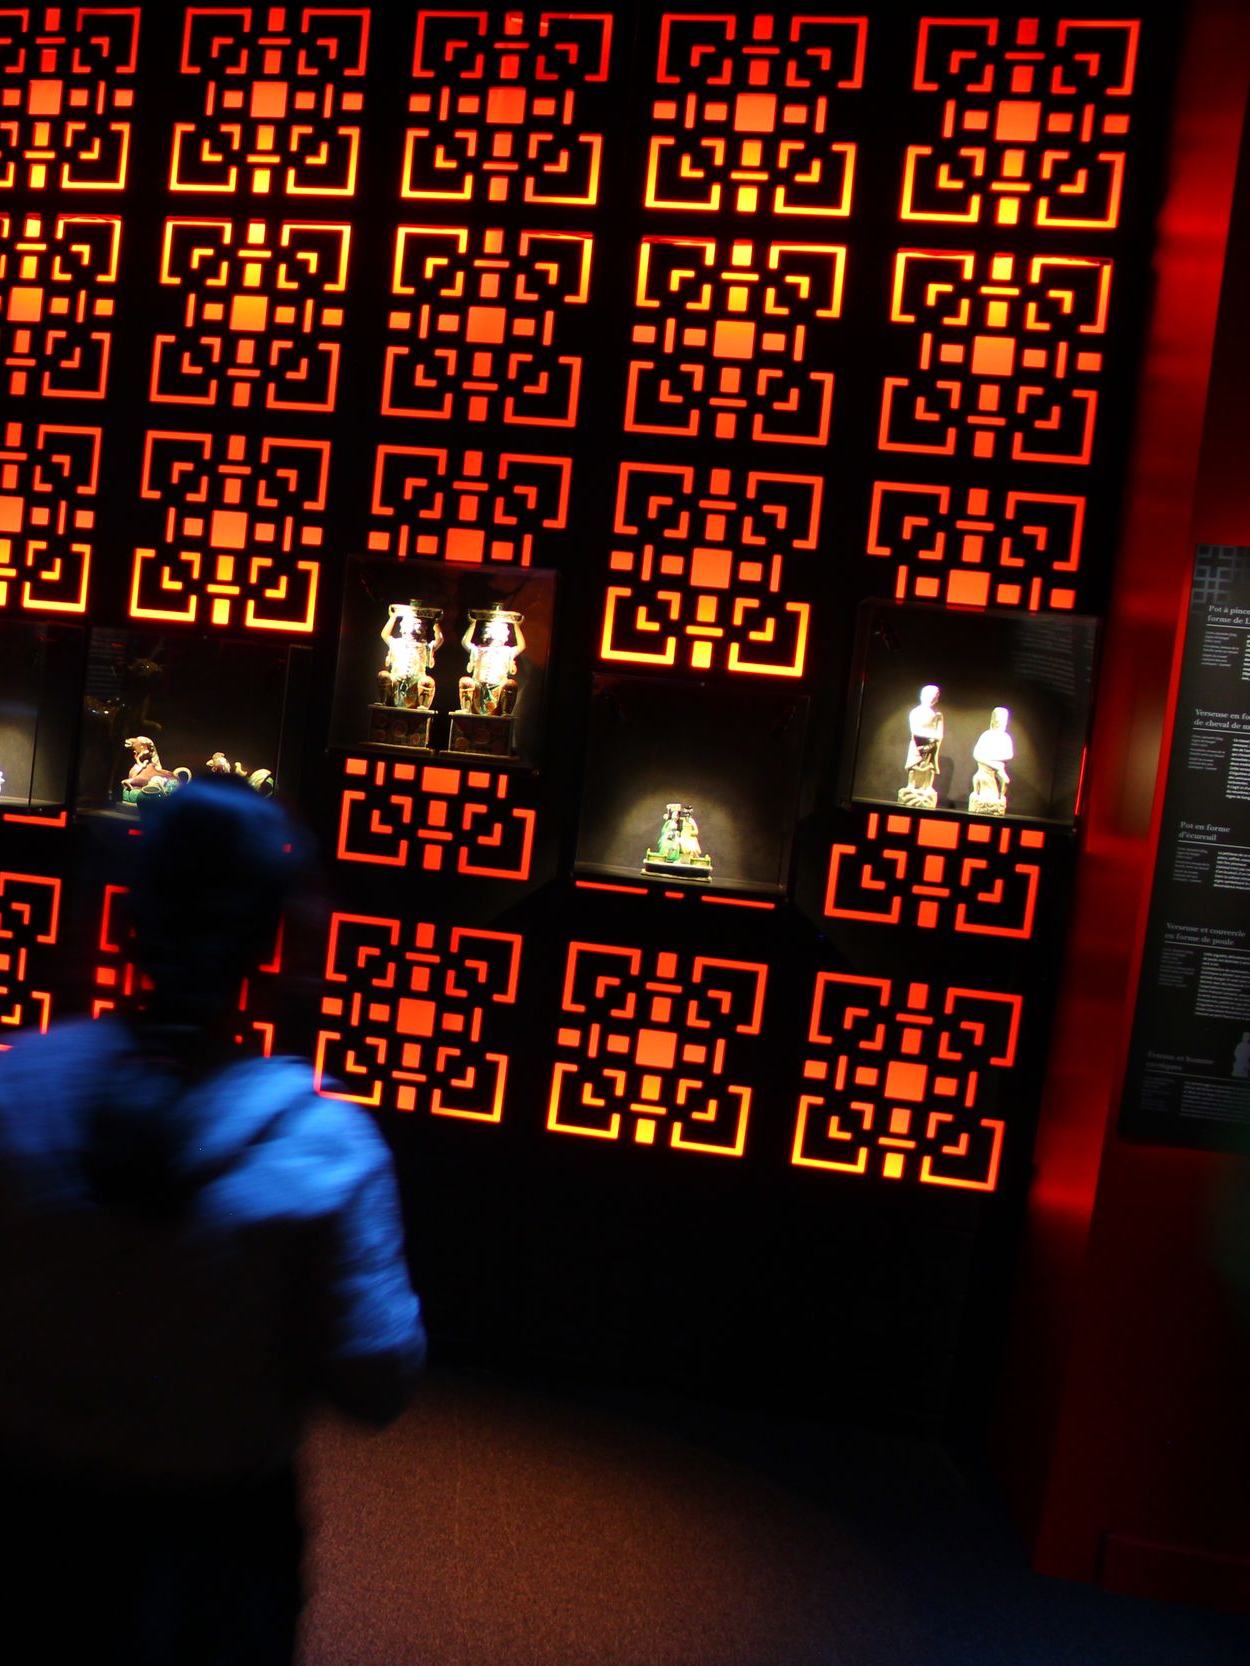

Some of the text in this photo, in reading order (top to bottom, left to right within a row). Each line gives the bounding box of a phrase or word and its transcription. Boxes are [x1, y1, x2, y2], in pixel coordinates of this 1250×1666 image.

[1208, 615, 1231, 623] forme
[1195, 709, 1229, 718] Verseuse
[1205, 720, 1230, 728] cheval
[1181, 821, 1194, 829] Pot
[1206, 823, 1230, 832] forme
